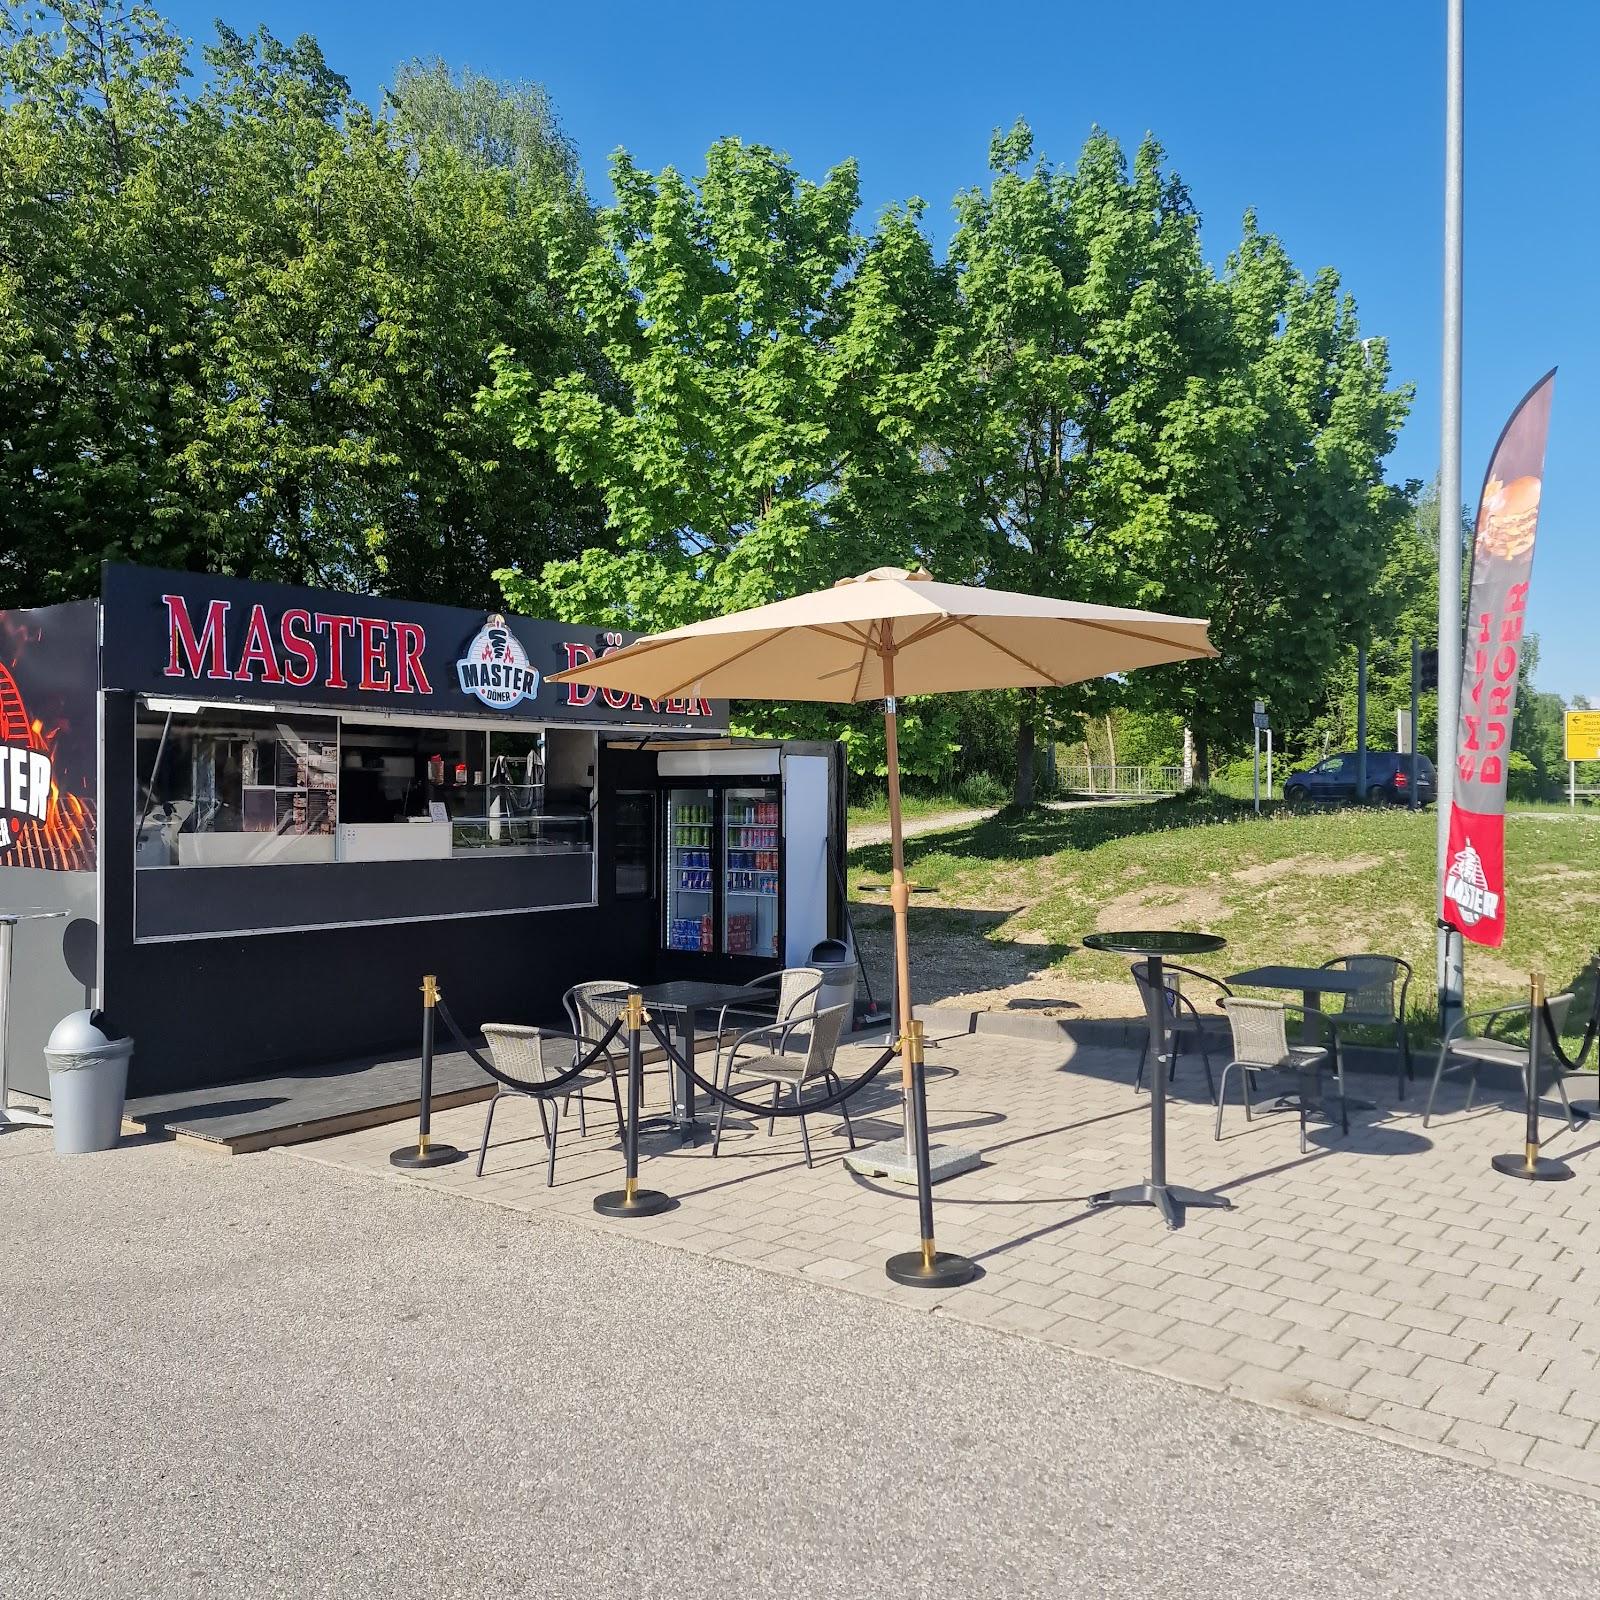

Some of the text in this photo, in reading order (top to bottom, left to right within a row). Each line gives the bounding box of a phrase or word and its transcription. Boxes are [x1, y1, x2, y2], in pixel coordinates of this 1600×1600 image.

[162, 594, 433, 695] MASTER
[463, 662, 535, 694] MASTER
[486, 689, 511, 702] DÖNER
[1479, 581, 1530, 785] BURGER
